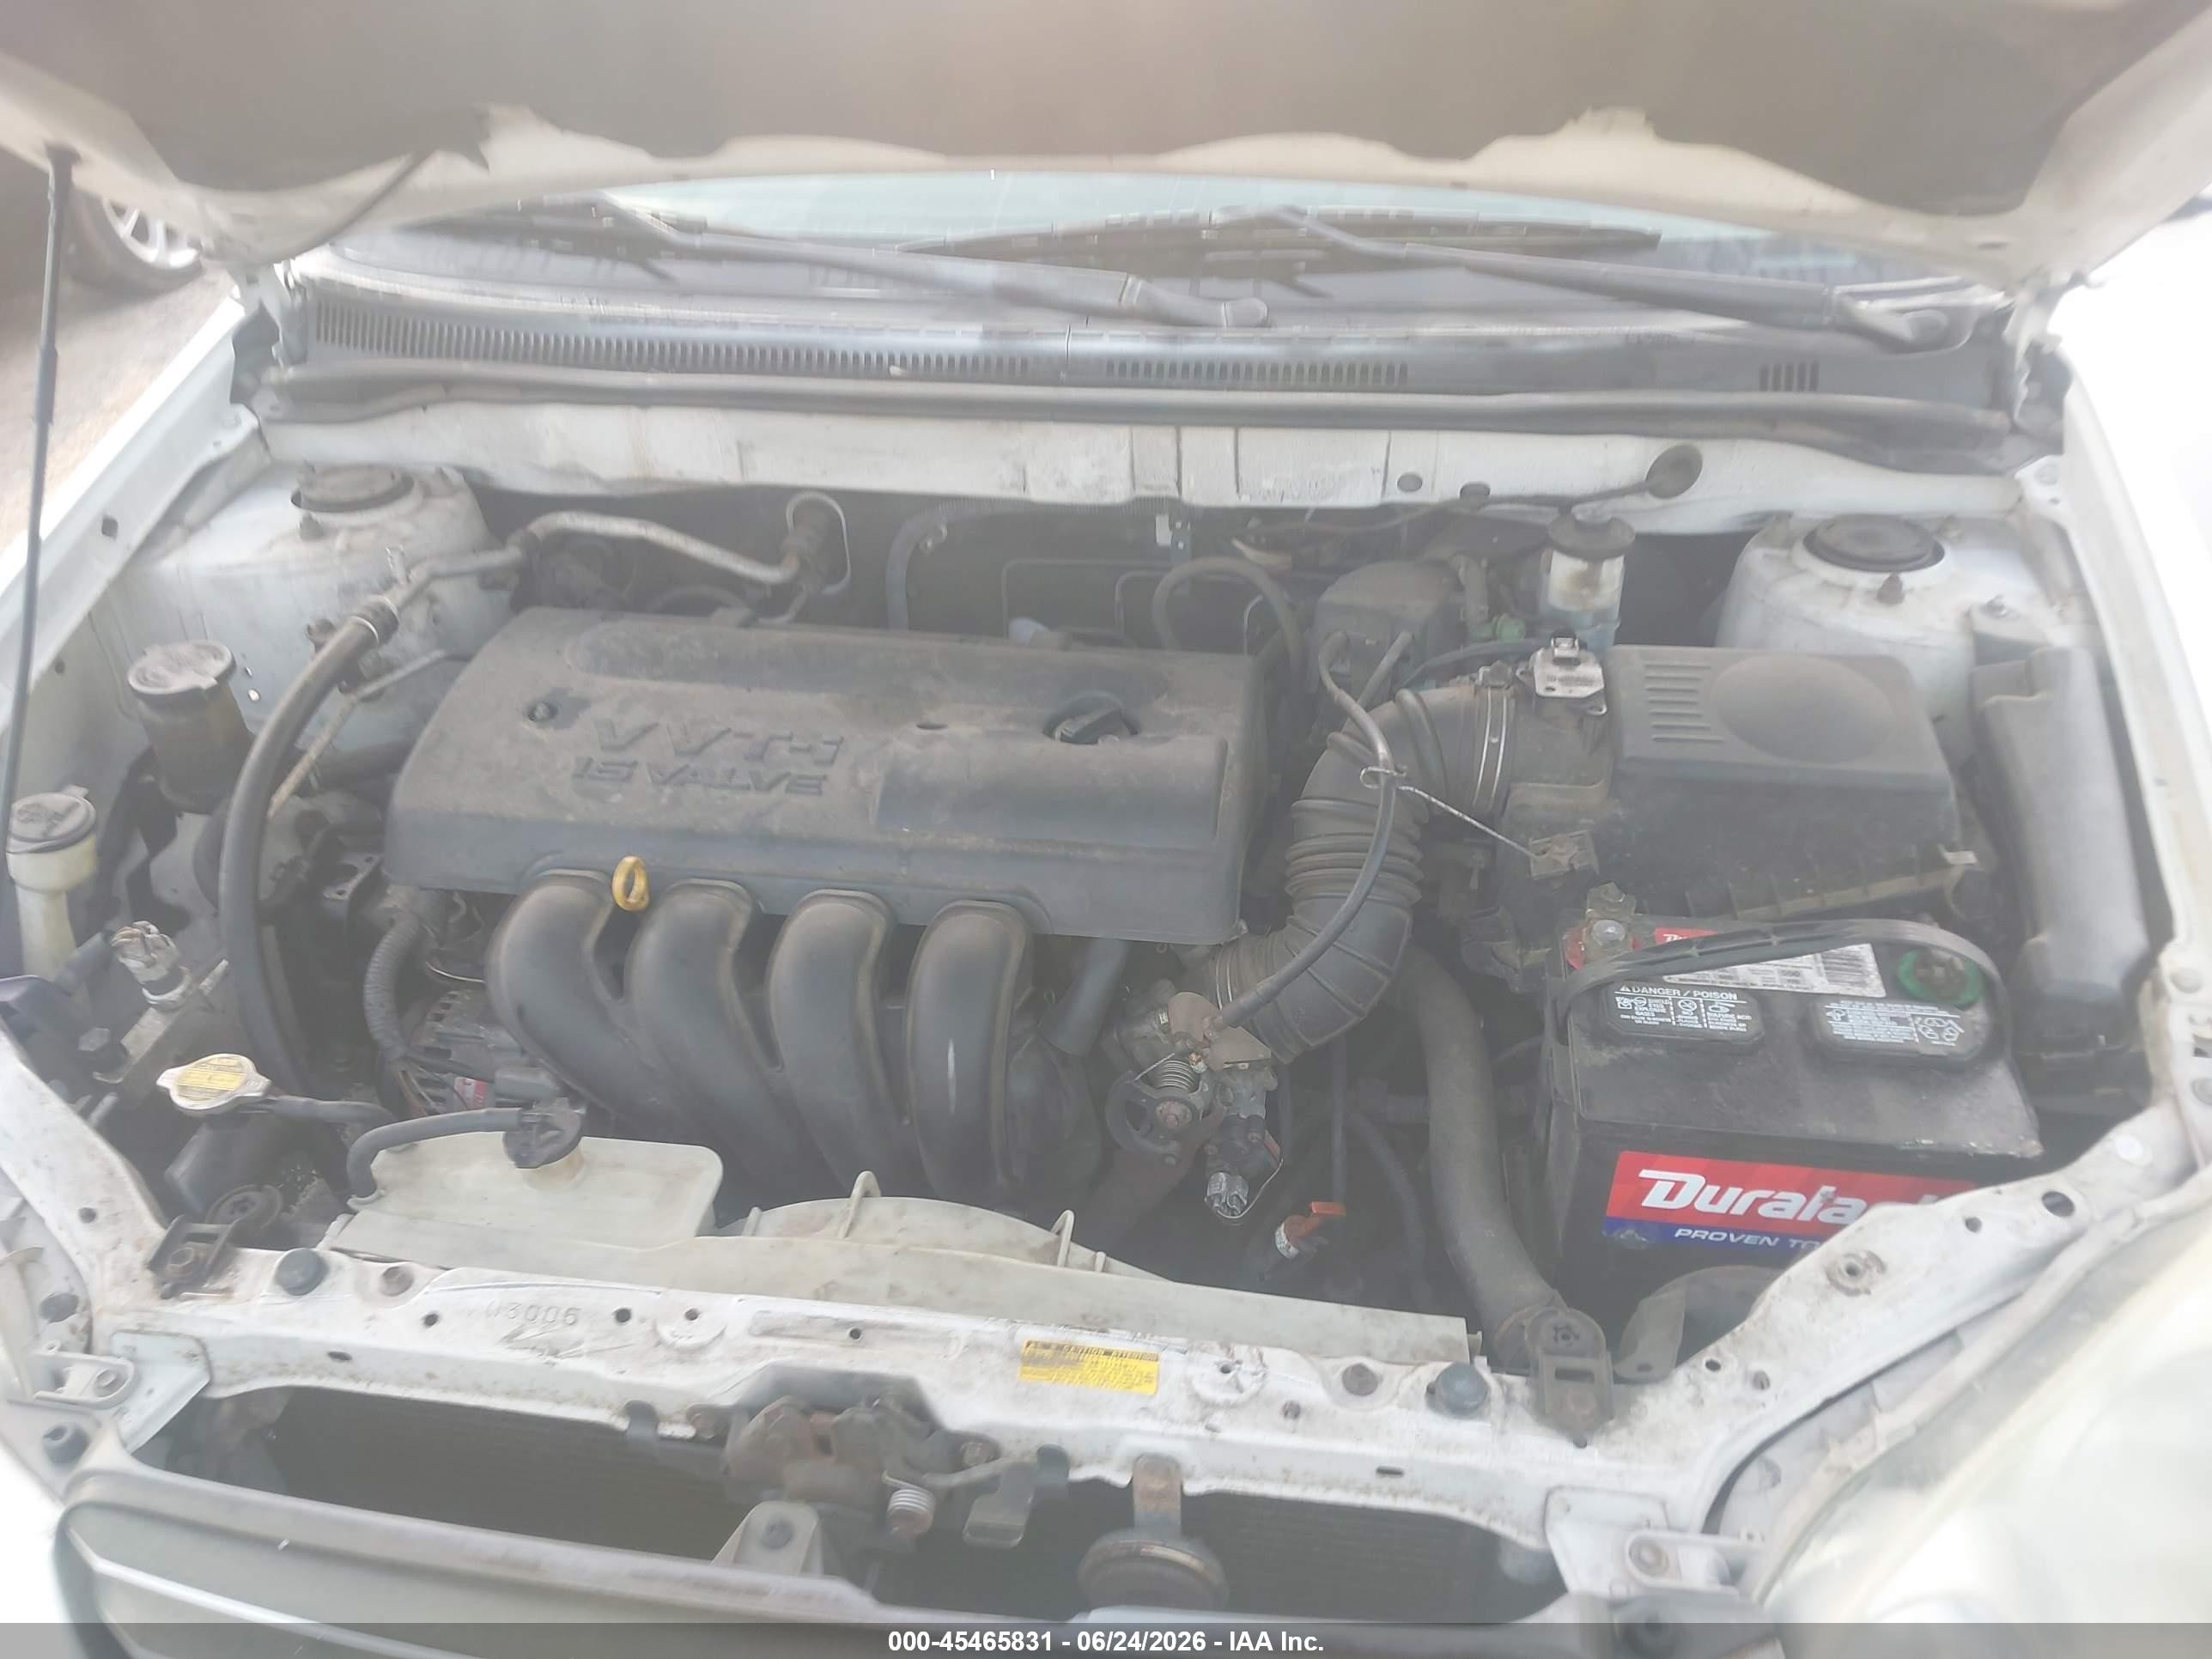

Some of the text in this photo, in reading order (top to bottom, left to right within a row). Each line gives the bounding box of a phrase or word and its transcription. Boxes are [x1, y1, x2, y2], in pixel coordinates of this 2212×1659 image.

[646, 762, 828, 797] VALVE
[1632, 986, 1680, 996] DANGER
[1693, 990, 1738, 1000] POISON
[1638, 1169, 1940, 1225] Durala
[1674, 1228, 1780, 1247] PROVEN
